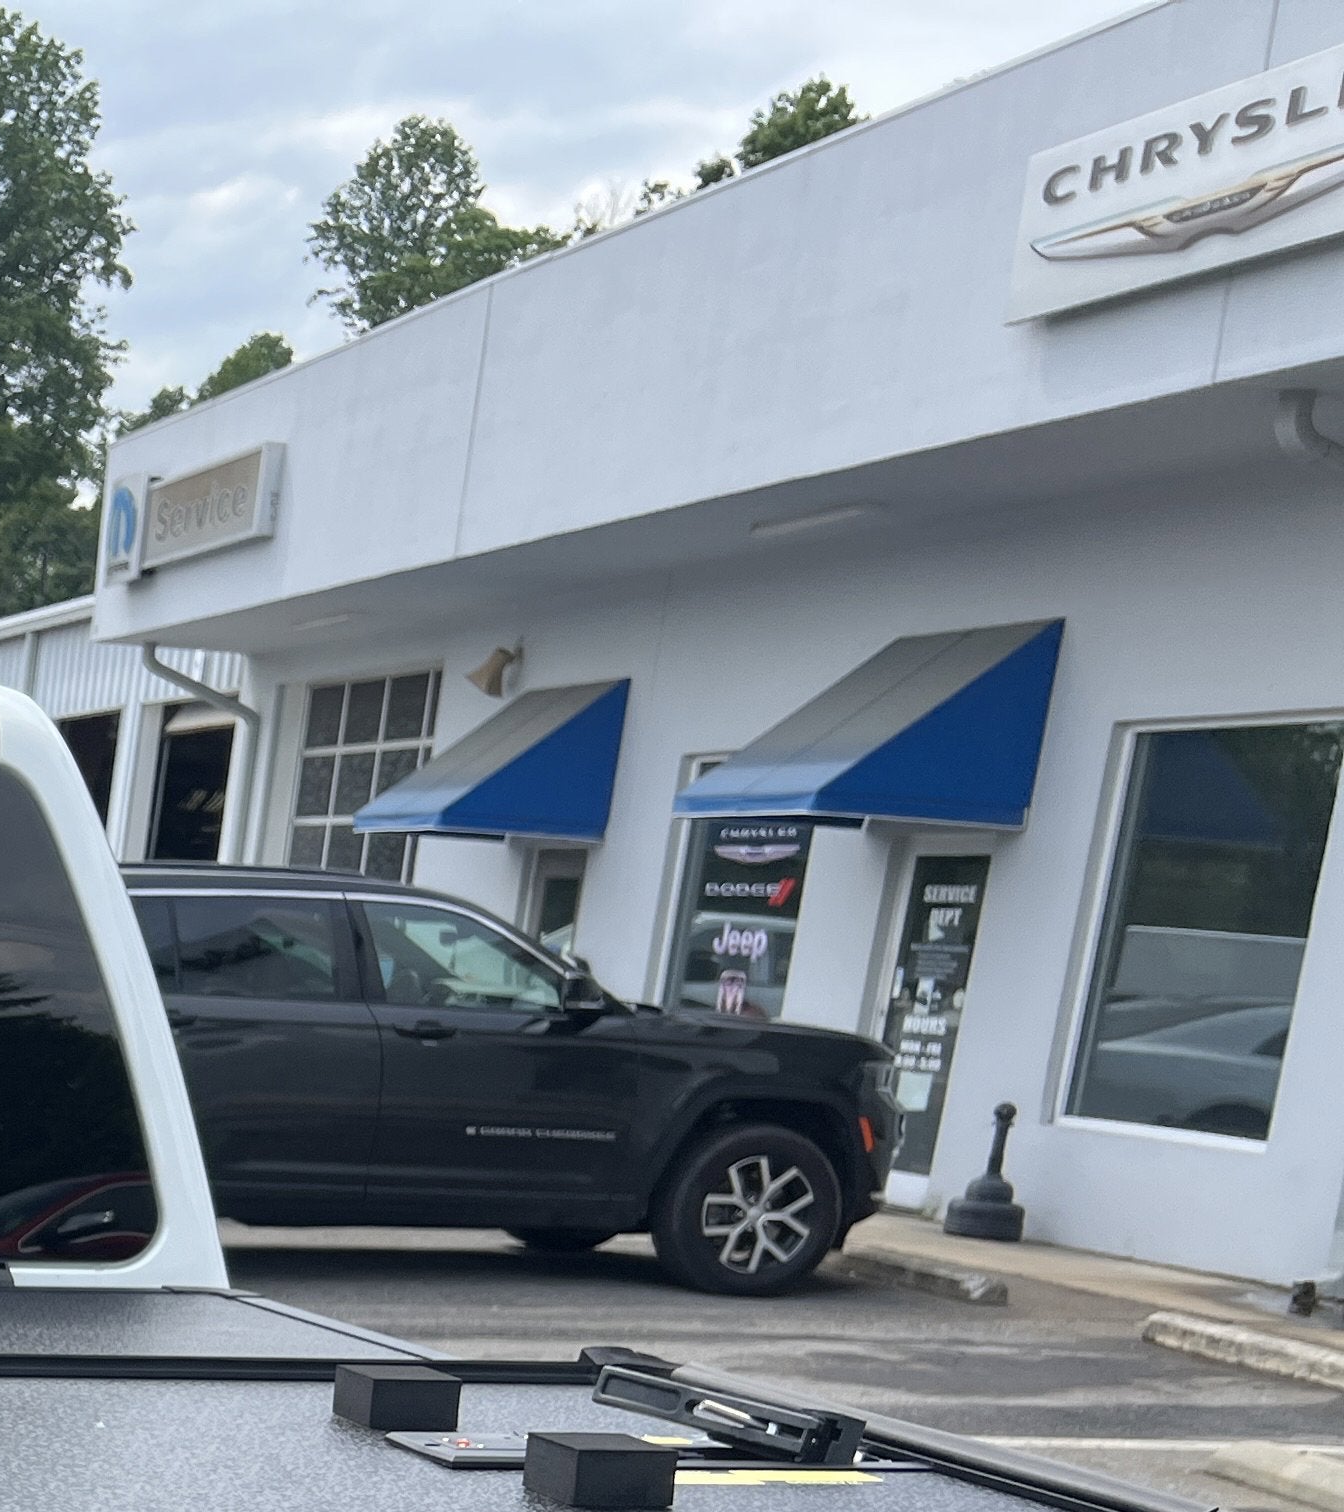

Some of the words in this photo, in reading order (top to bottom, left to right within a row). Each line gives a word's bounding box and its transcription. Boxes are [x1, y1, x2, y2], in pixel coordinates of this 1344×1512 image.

[1042, 69, 1344, 206] CHRYSL
[154, 484, 250, 542] Service
[923, 884, 978, 904] SERVICE
[712, 921, 769, 962] Jeep
[902, 1014, 948, 1036] HOURS
